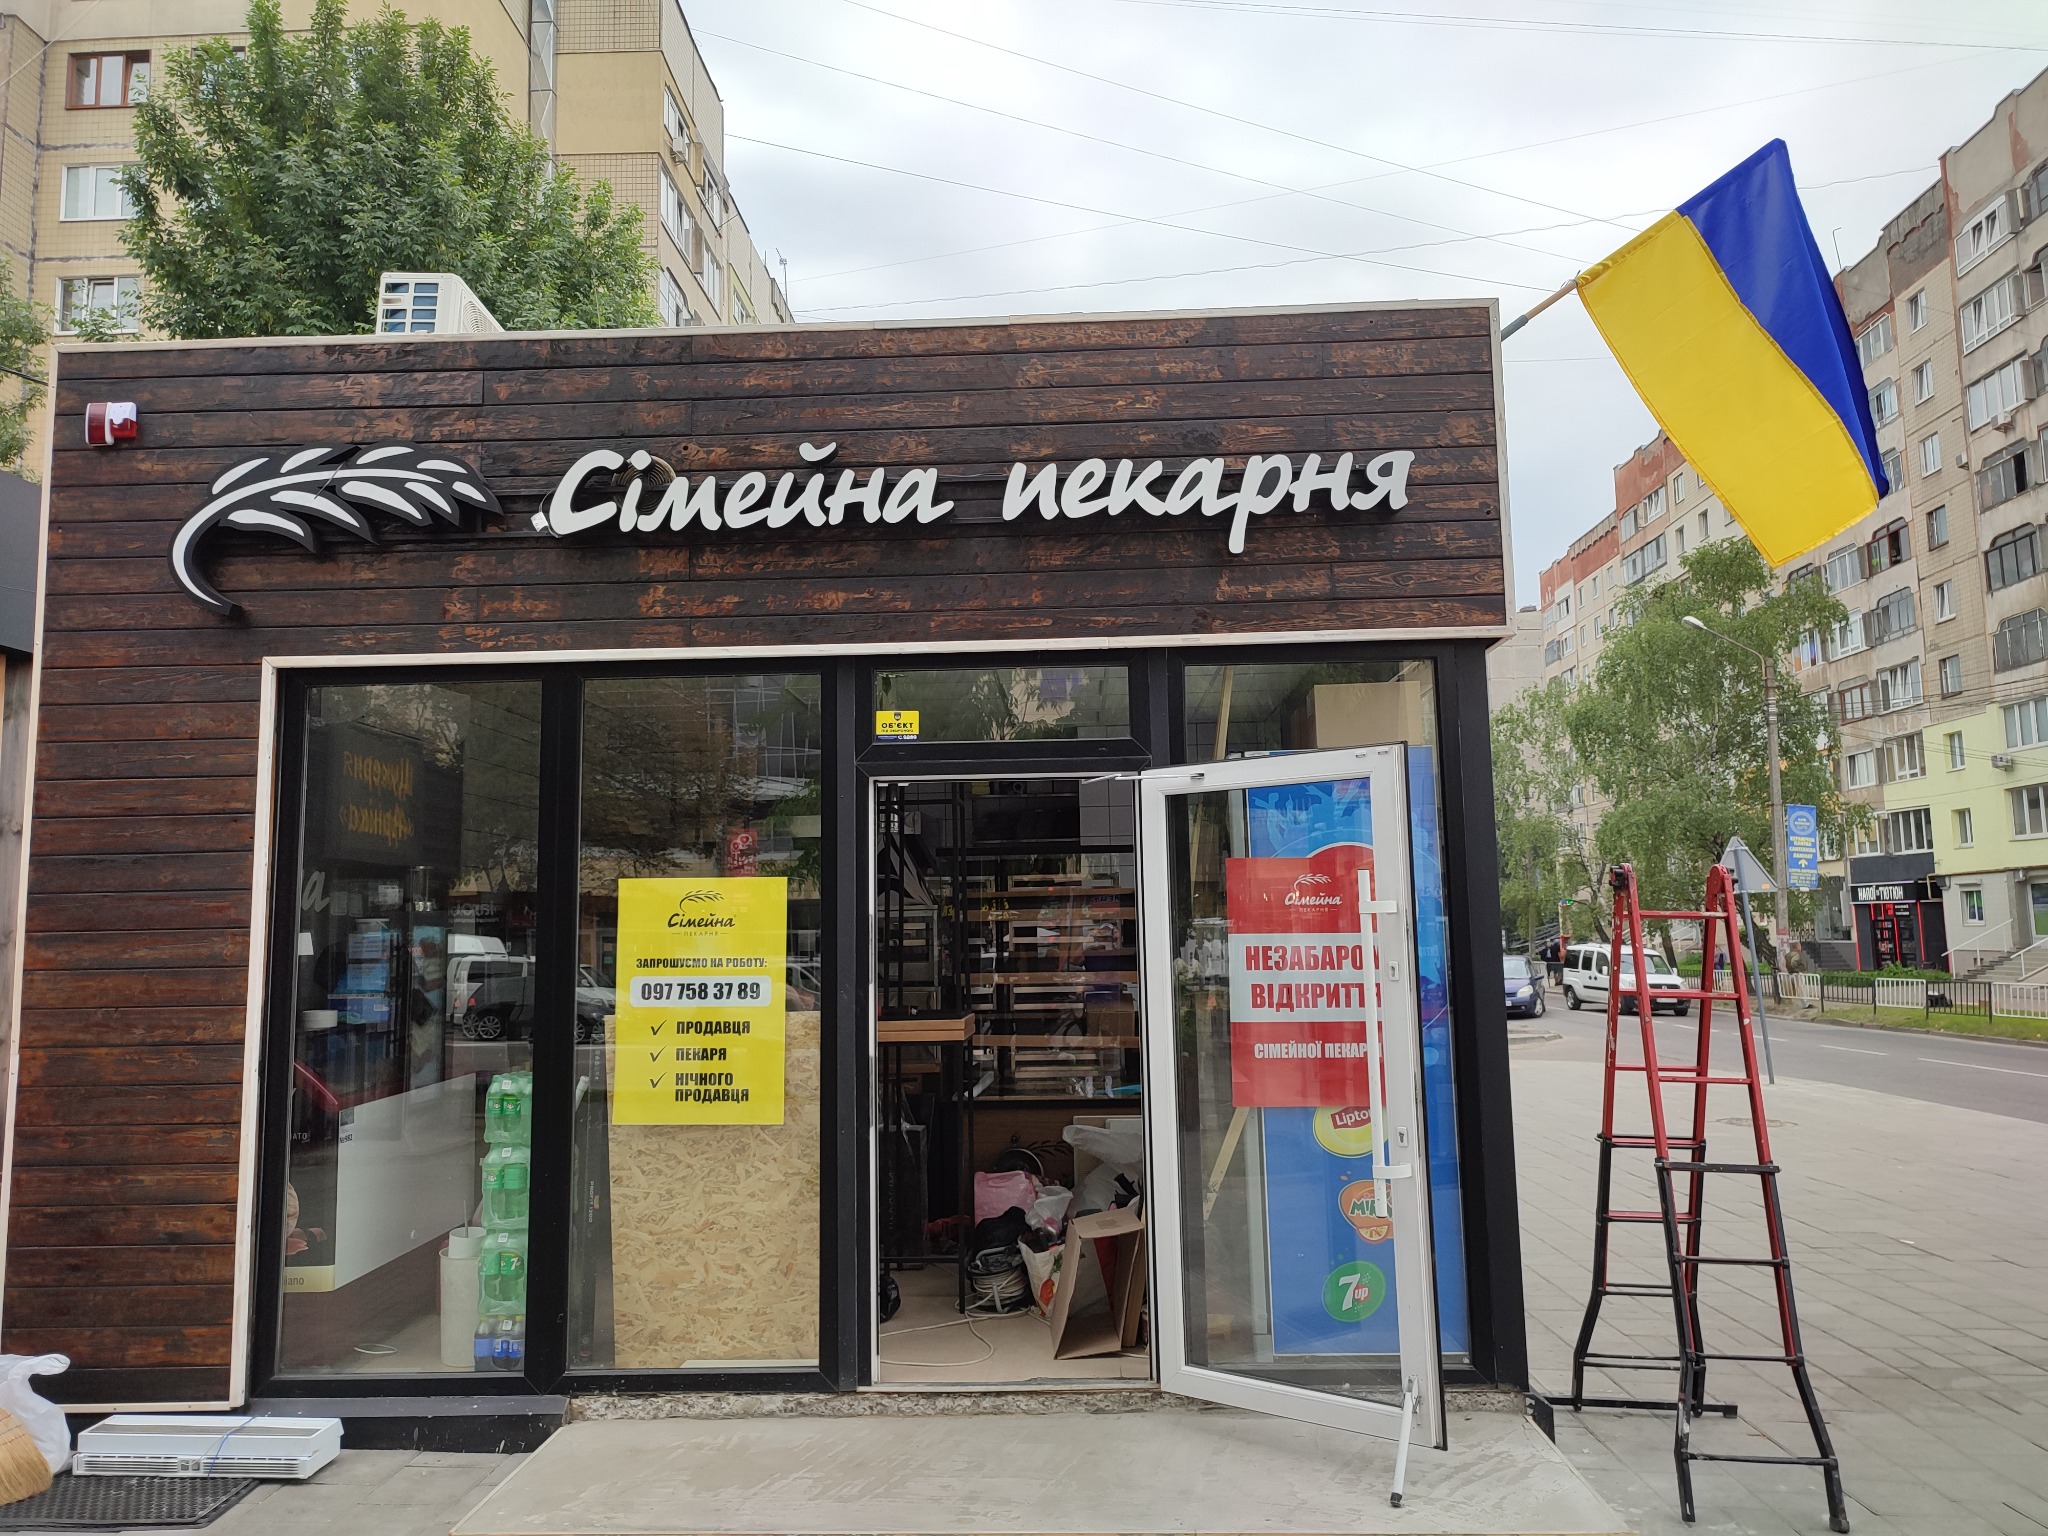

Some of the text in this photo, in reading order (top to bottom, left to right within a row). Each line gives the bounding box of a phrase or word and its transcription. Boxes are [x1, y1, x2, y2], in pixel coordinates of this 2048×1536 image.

[548, 441, 1415, 554] Сімейна пекарня
[1284, 892, 1343, 906] Сімейна
[667, 912, 736, 928] Сімейна
[636, 957, 768, 969] ЗАПРОШУЄМО НА РОБОТУ:
[641, 982, 761, 1001] 097 758 37 89
[676, 1020, 751, 1035] ПРОДАВЦЯ
[675, 1047, 727, 1061] ПЕКАРЯ
[1254, 1039, 1323, 1059] СІМЕЙНОЇ
[675, 1072, 734, 1086] НІЧНОГО
[674, 1088, 749, 1103] ПРОДАВЦЯ
[1335, 1107, 1372, 1127] Lipto
